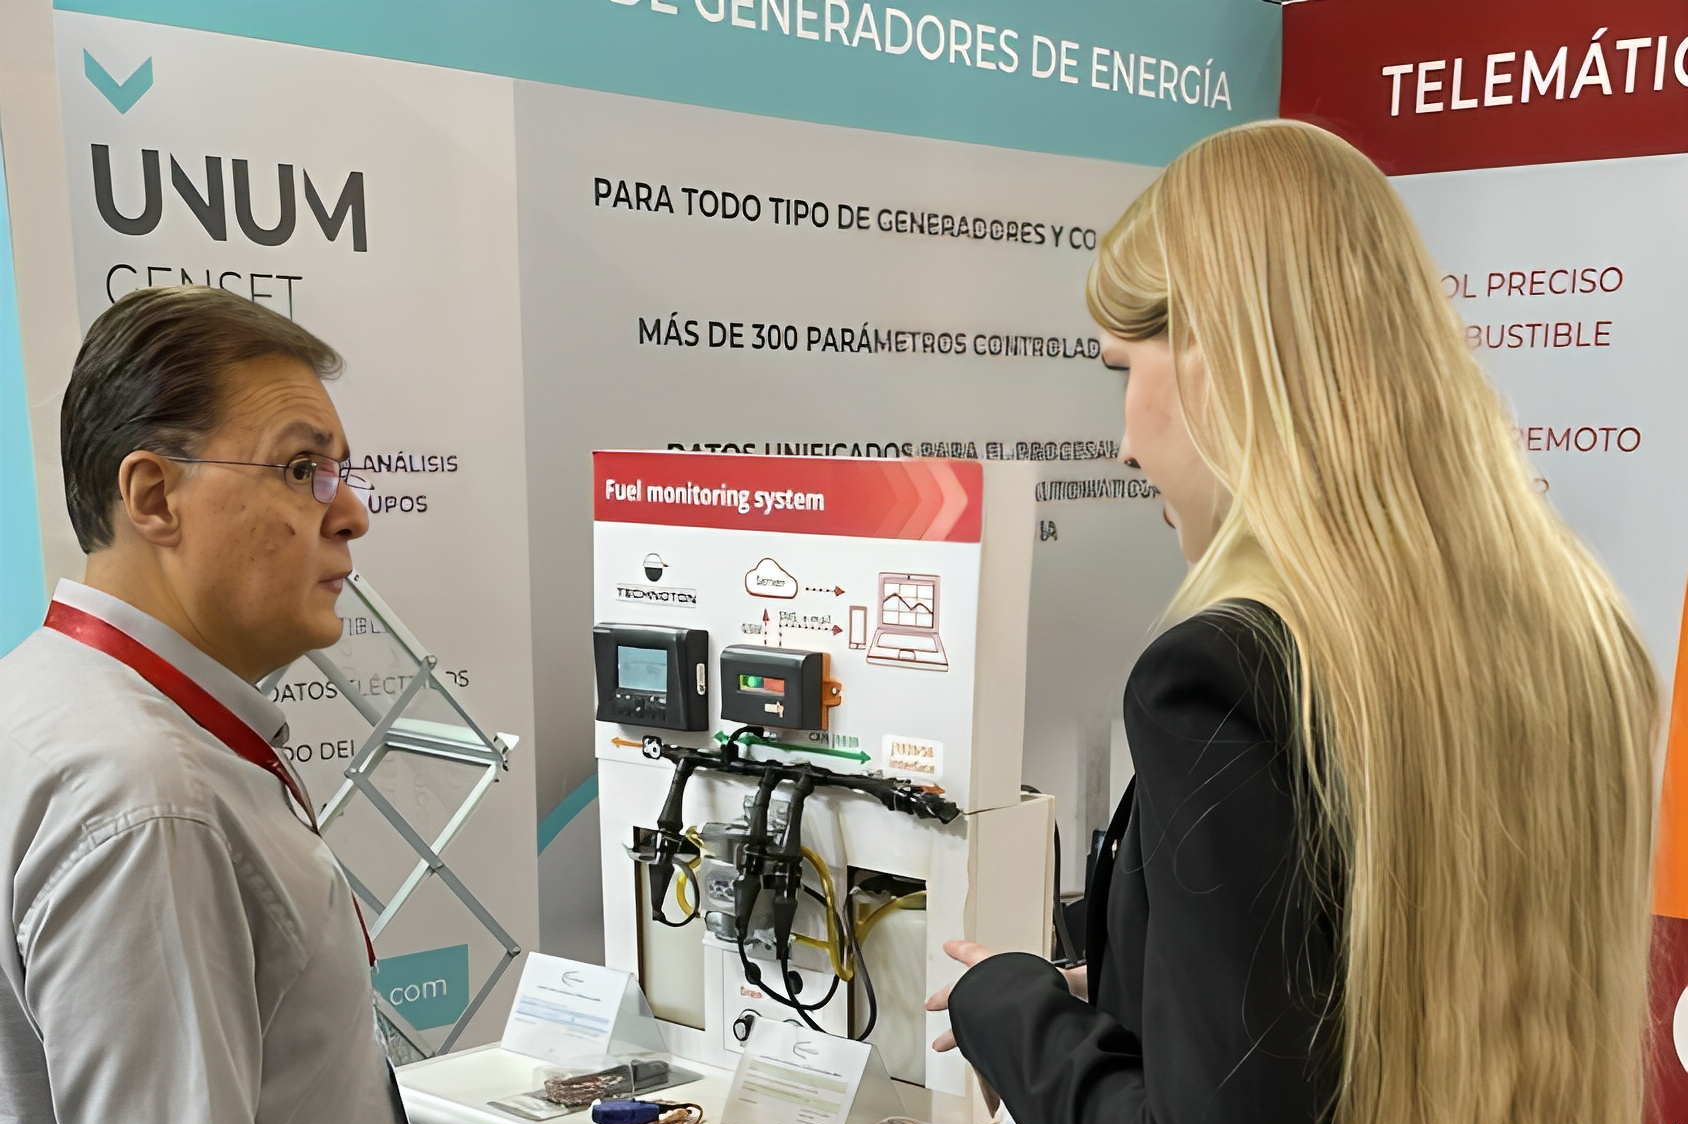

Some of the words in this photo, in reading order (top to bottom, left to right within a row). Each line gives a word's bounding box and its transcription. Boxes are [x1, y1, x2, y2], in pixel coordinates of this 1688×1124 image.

[1032, 35, 1080, 84] DE
[1091, 46, 1232, 111] ENERGÍA
[91, 144, 367, 252] UNUM
[594, 177, 674, 213] PARA
[681, 187, 761, 222] TODO
[769, 197, 829, 228] TIPO
[837, 204, 870, 230] DE
[1050, 225, 1064, 247] Y
[1069, 227, 1097, 250] CO
[1487, 266, 1623, 297] PRECISO
[638, 312, 700, 347] MÁS
[708, 321, 744, 348] DE
[752, 323, 798, 351] 300
[806, 322, 967, 354] PARÁMETROS
[1463, 321, 1613, 349] BUSTIBLE
[363, 452, 458, 473] ANÁLISIS
[605, 479, 642, 502] Fuel
[647, 481, 750, 514] monitoring
[754, 488, 825, 515] system
[390, 979, 447, 1005] com
